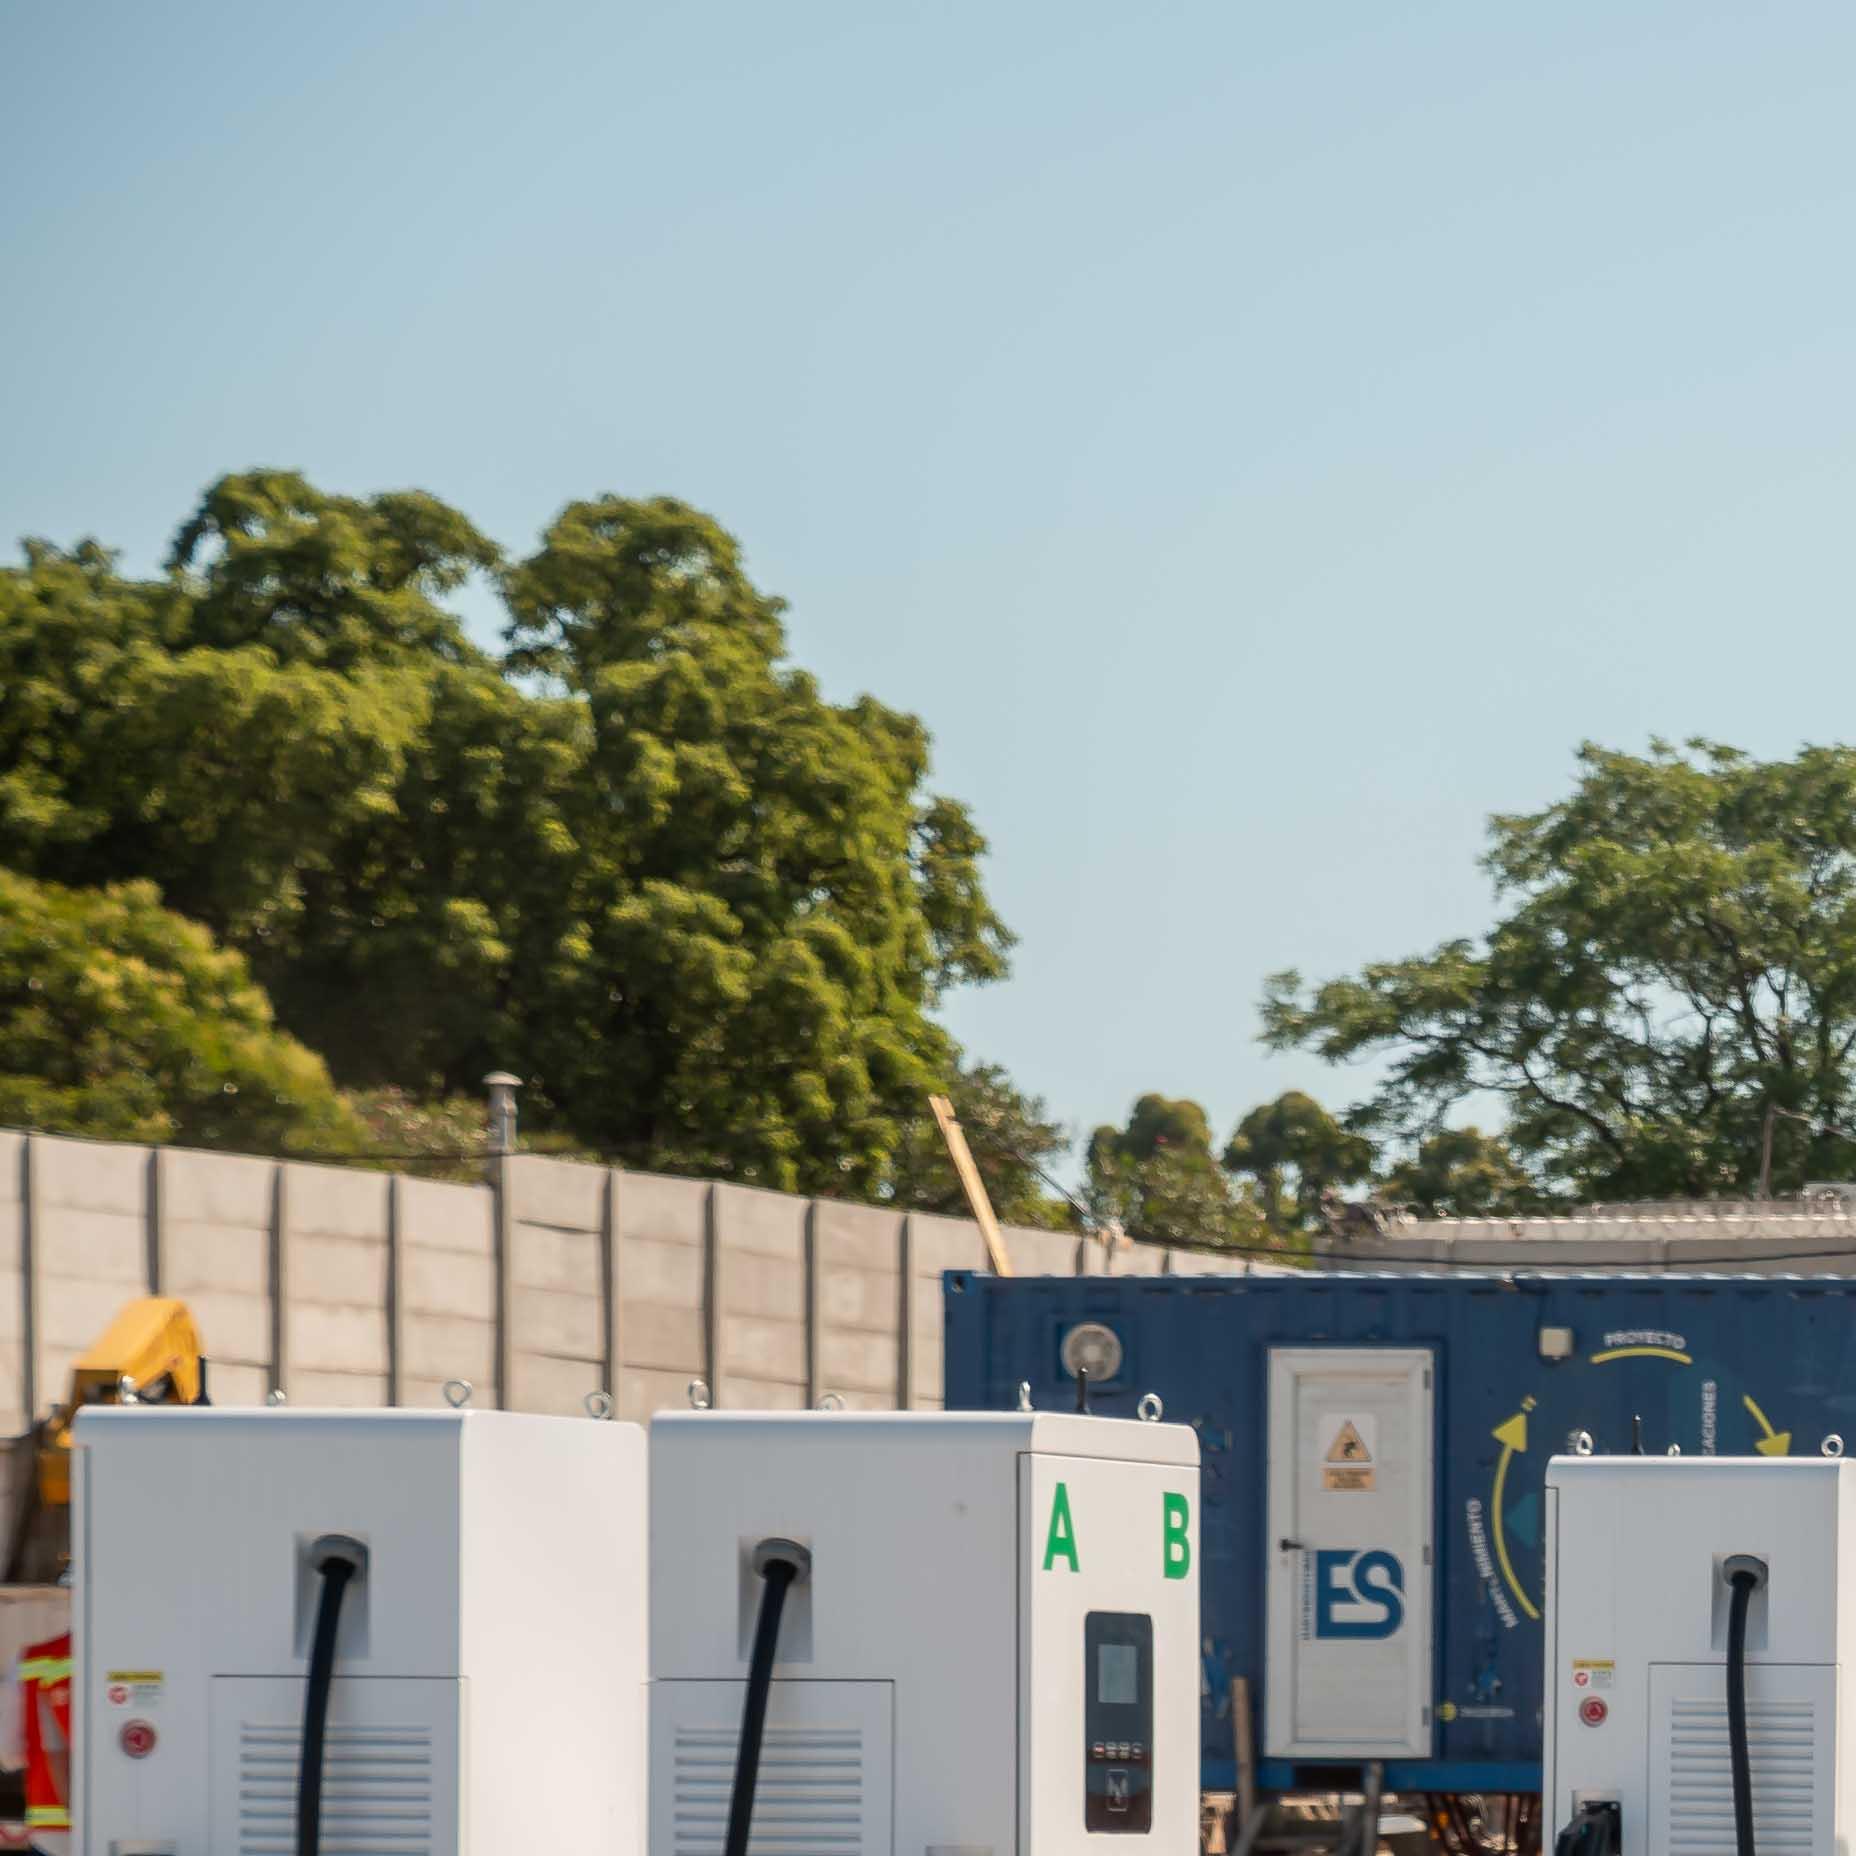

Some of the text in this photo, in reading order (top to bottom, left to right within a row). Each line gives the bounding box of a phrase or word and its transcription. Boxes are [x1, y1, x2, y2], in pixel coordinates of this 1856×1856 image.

[1604, 1328, 1686, 1350] PROYECTO
[1044, 1482, 1190, 1580] A B
[1316, 1549, 1404, 1638] ES
